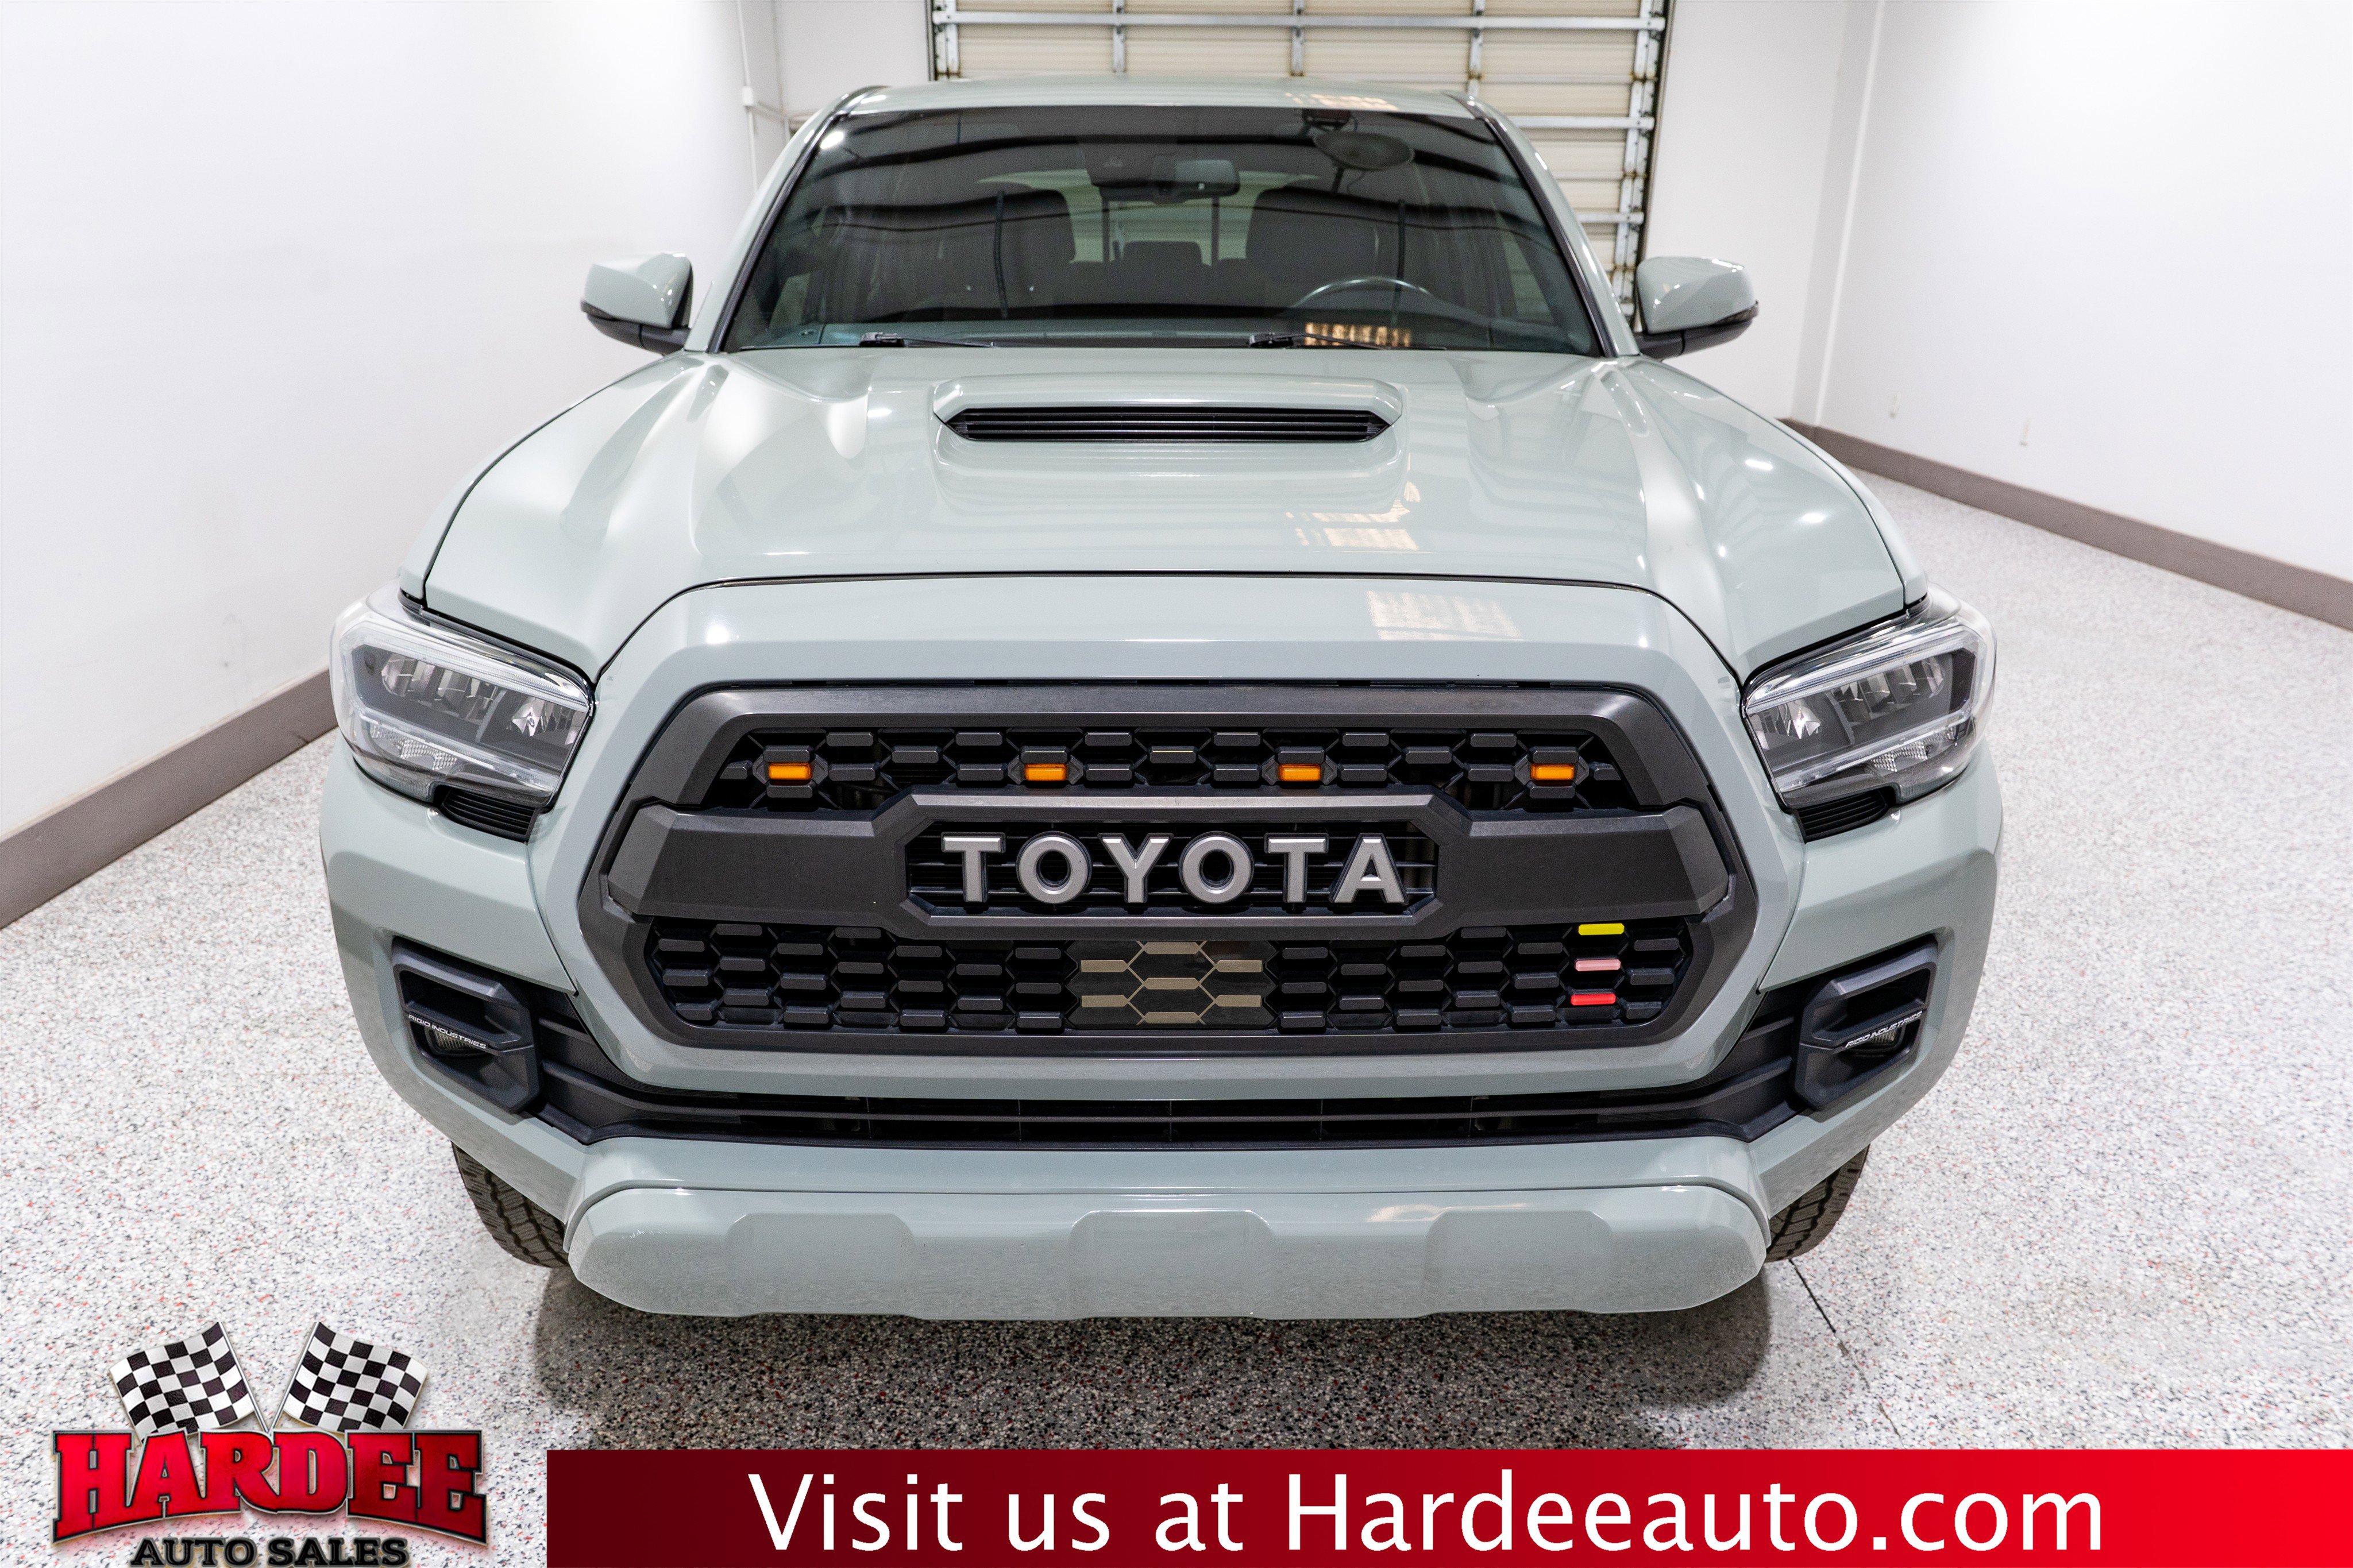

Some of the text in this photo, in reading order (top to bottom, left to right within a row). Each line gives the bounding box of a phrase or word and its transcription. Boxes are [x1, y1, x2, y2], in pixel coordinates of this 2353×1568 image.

[942, 832, 1407, 905] TOYOTA
[408, 1014, 487, 1049] RIGID INDUSTRIES
